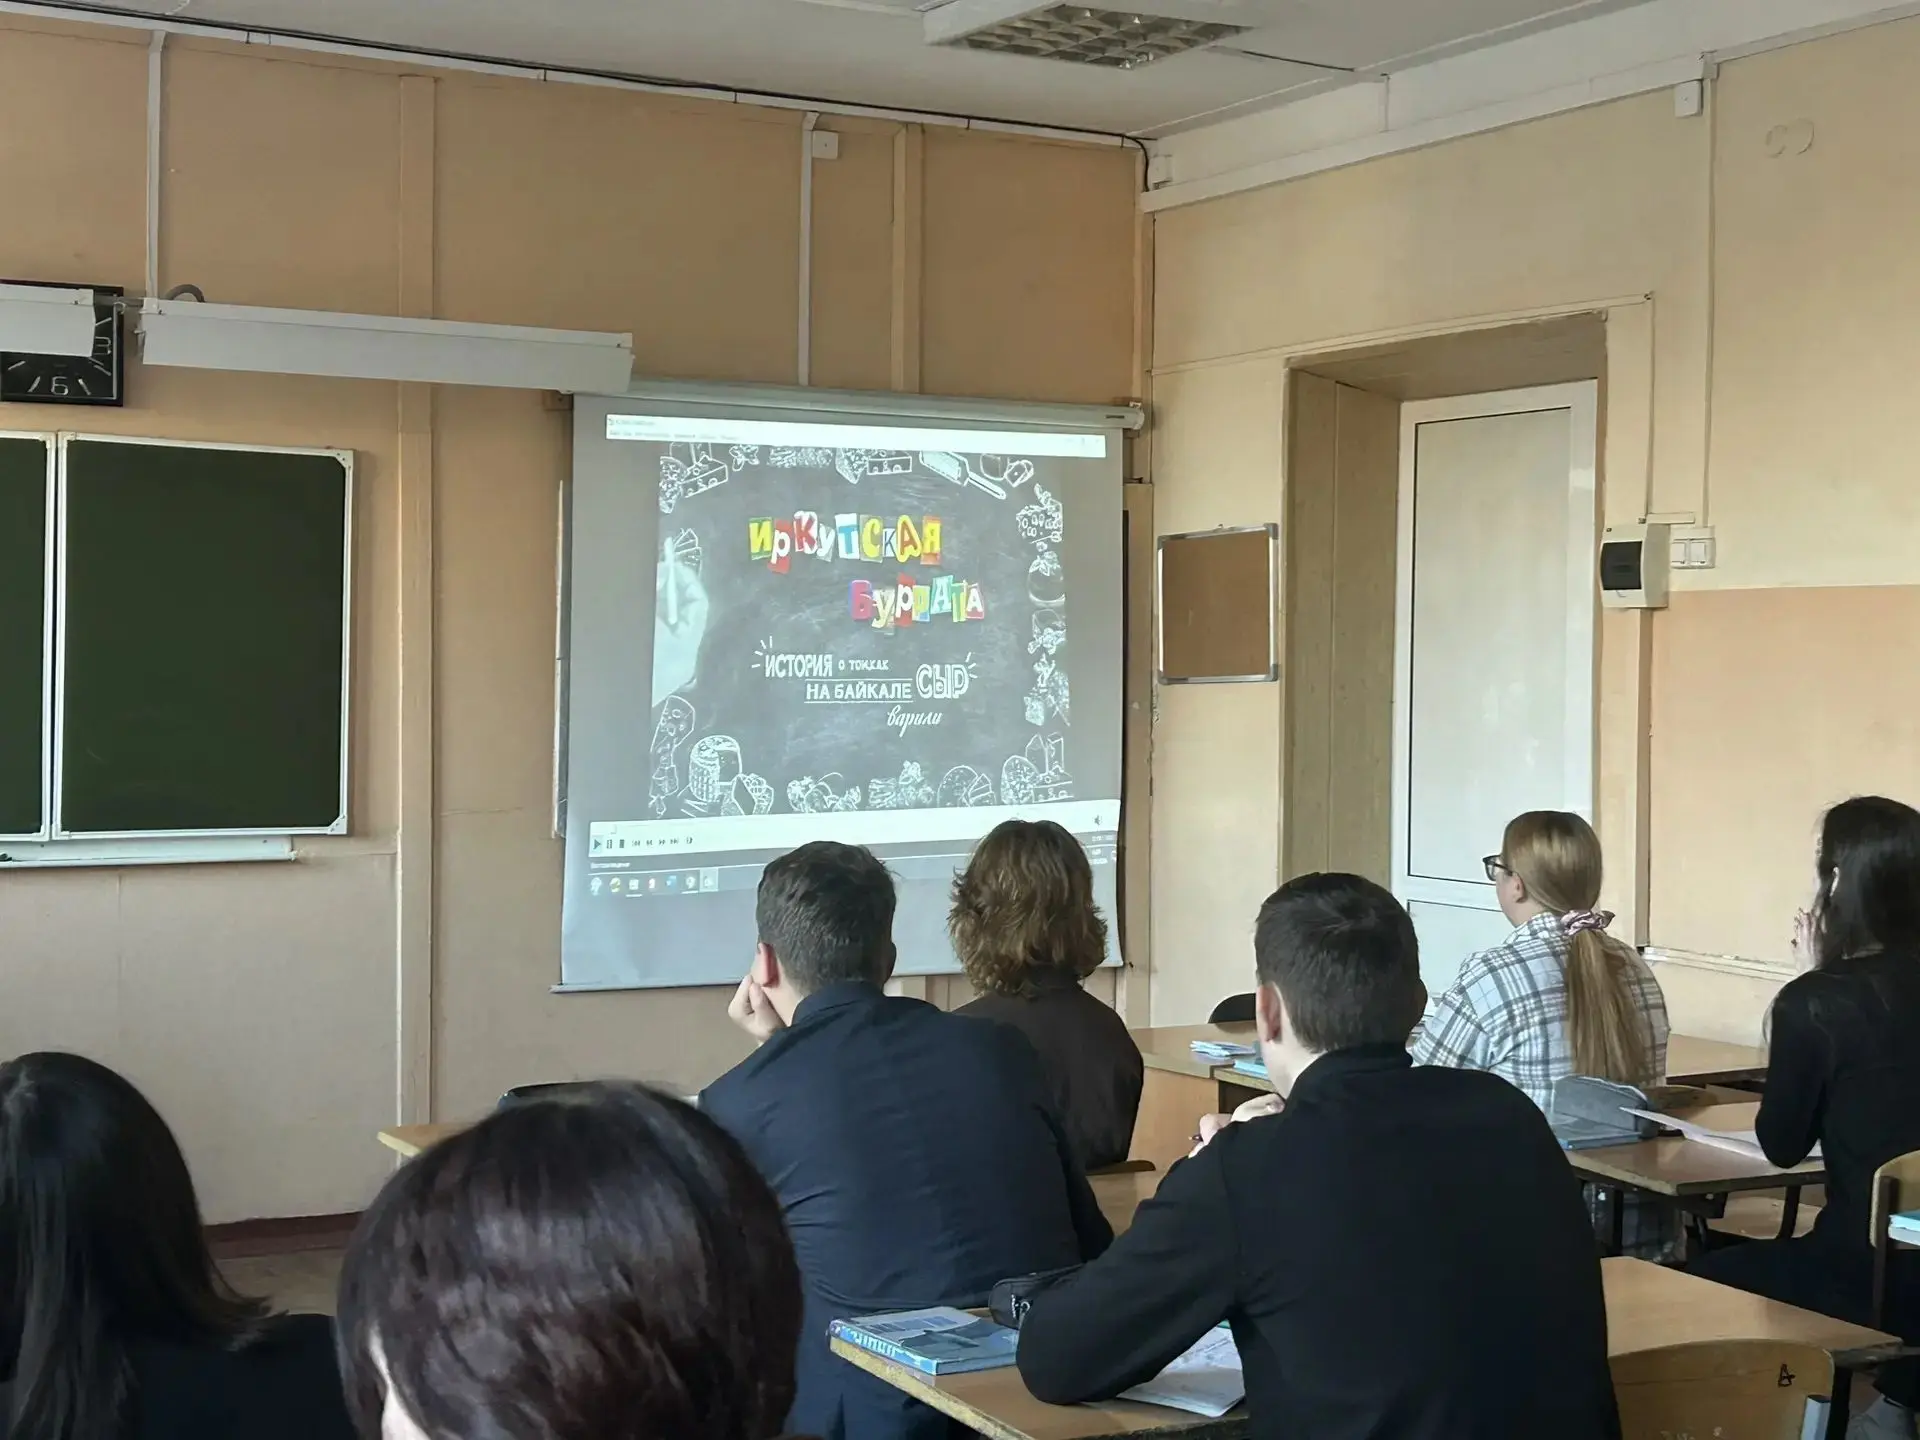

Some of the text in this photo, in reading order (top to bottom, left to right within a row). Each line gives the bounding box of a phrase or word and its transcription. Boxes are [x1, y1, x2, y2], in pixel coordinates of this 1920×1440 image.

[51, 376, 69, 396] 6
[765, 654, 833, 678] ИСТОРИЯ
[806, 664, 969, 700] НА БАЙКАЛЕ СЫР
[887, 704, 943, 737] варили
